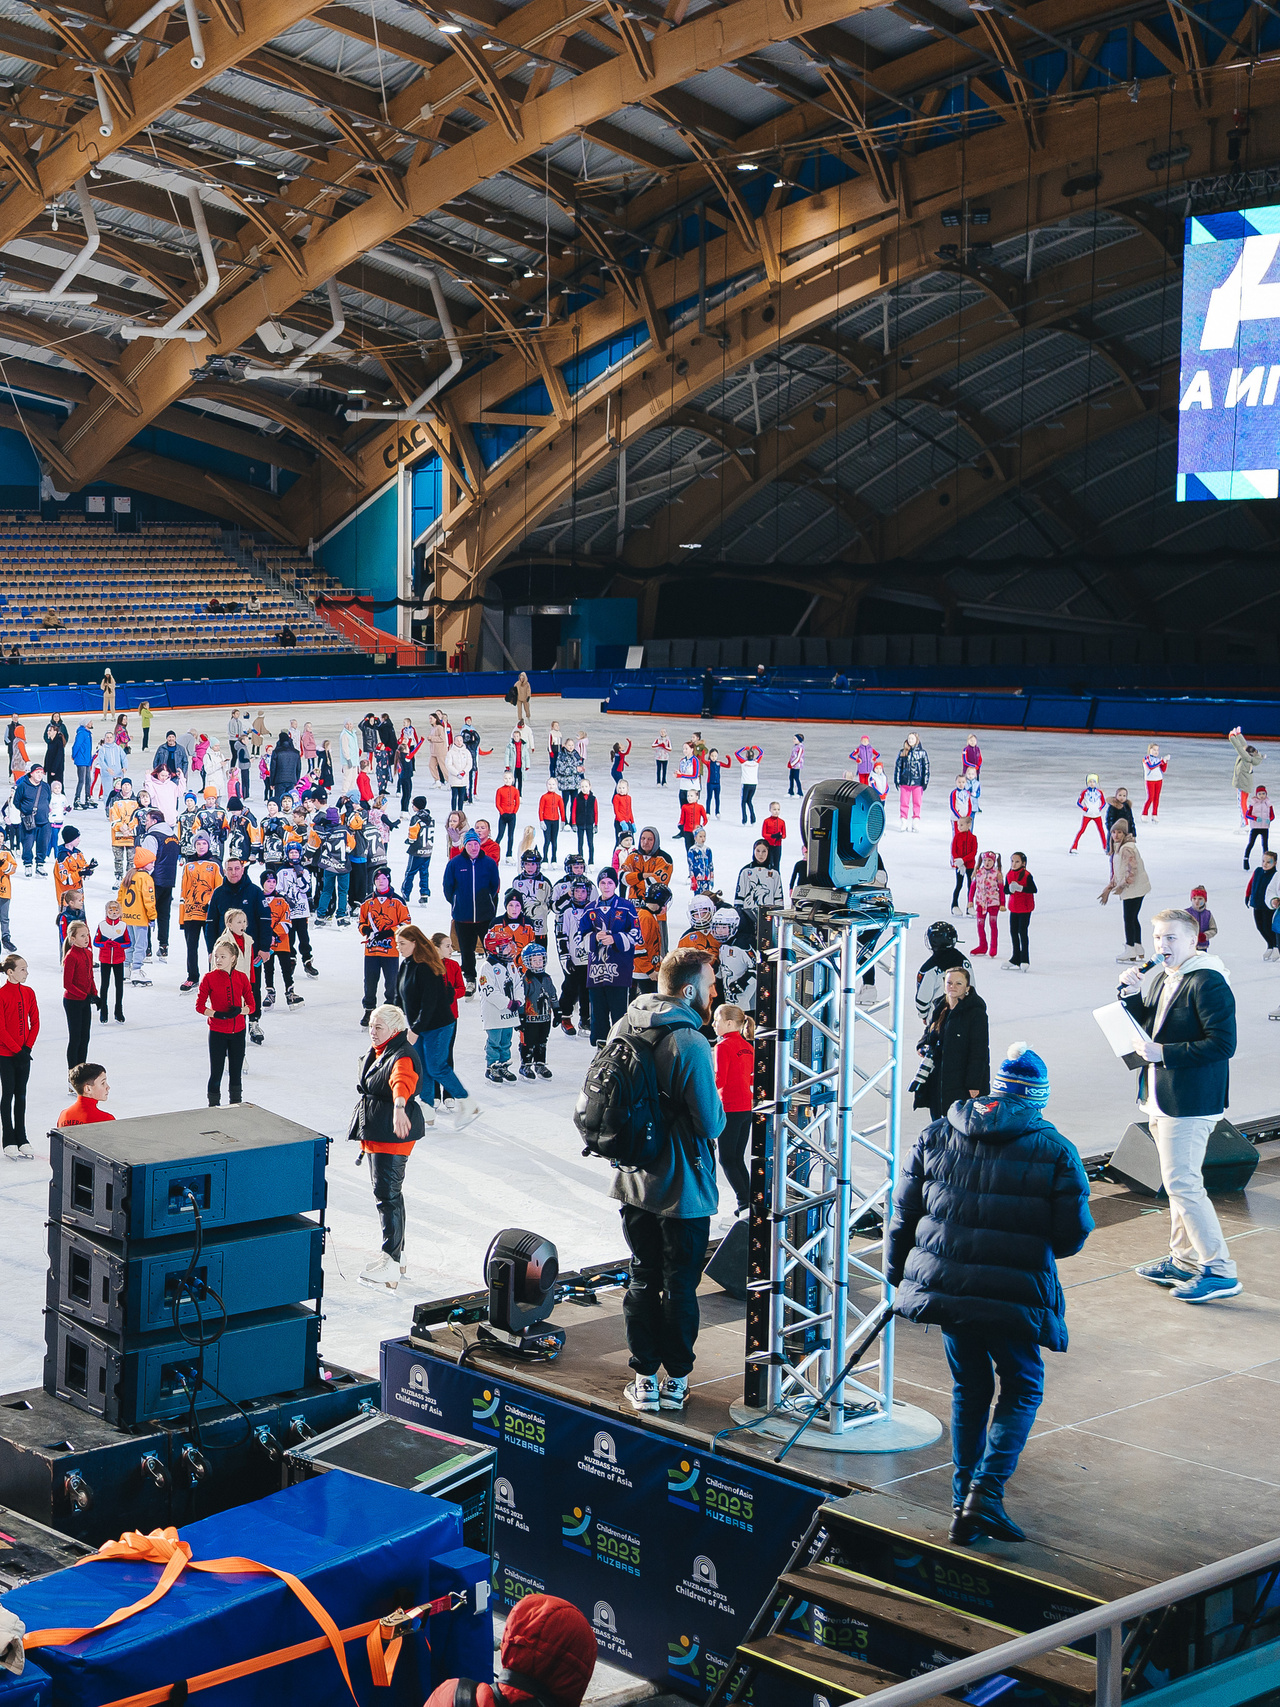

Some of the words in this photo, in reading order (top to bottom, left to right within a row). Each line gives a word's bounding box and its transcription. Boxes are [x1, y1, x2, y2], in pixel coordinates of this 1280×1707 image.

[483, 984, 494, 997] 25
[395, 1393, 420, 1408] Children
[421, 1402, 428, 1411] of
[429, 1404, 443, 1417] Asia
[401, 1387, 424, 1401] KUZBASS
[424, 1396, 437, 1405] 2023
[504, 1404, 526, 1419] Children
[526, 1413, 533, 1421] of
[533, 1414, 545, 1425] Asia
[504, 1415, 545, 1443] 2023
[504, 1434, 545, 1455] KUZBASS
[577, 1461, 606, 1478] Children
[617, 1476, 633, 1488] Asia
[584, 1455, 611, 1470] KUZBASS
[611, 1465, 625, 1475] 2023
[706, 1477, 732, 1492] Children
[733, 1486, 739, 1495] of
[739, 1488, 753, 1500] Asia
[510, 1510, 523, 1520] 2023
[706, 1488, 753, 1520] 2023
[515, 1520, 530, 1532] Asia
[706, 1508, 753, 1532] KUZBASS
[596, 1523, 621, 1538] Children
[621, 1532, 627, 1541] of
[627, 1534, 640, 1546] Asia
[597, 1533, 640, 1565] 2023
[597, 1553, 640, 1577] KUZBASS
[504, 1568, 526, 1583] Children
[533, 1580, 545, 1591] Asia
[683, 1579, 712, 1595] KUZBASS
[713, 1591, 727, 1602] 2023
[676, 1584, 706, 1603] Children
[708, 1599, 716, 1608] of
[718, 1601, 735, 1615] Asia
[611, 1635, 625, 1646] 2023
[814, 1620, 868, 1649] 2023
[607, 1642, 616, 1651] of
[617, 1646, 633, 1659] Asia
